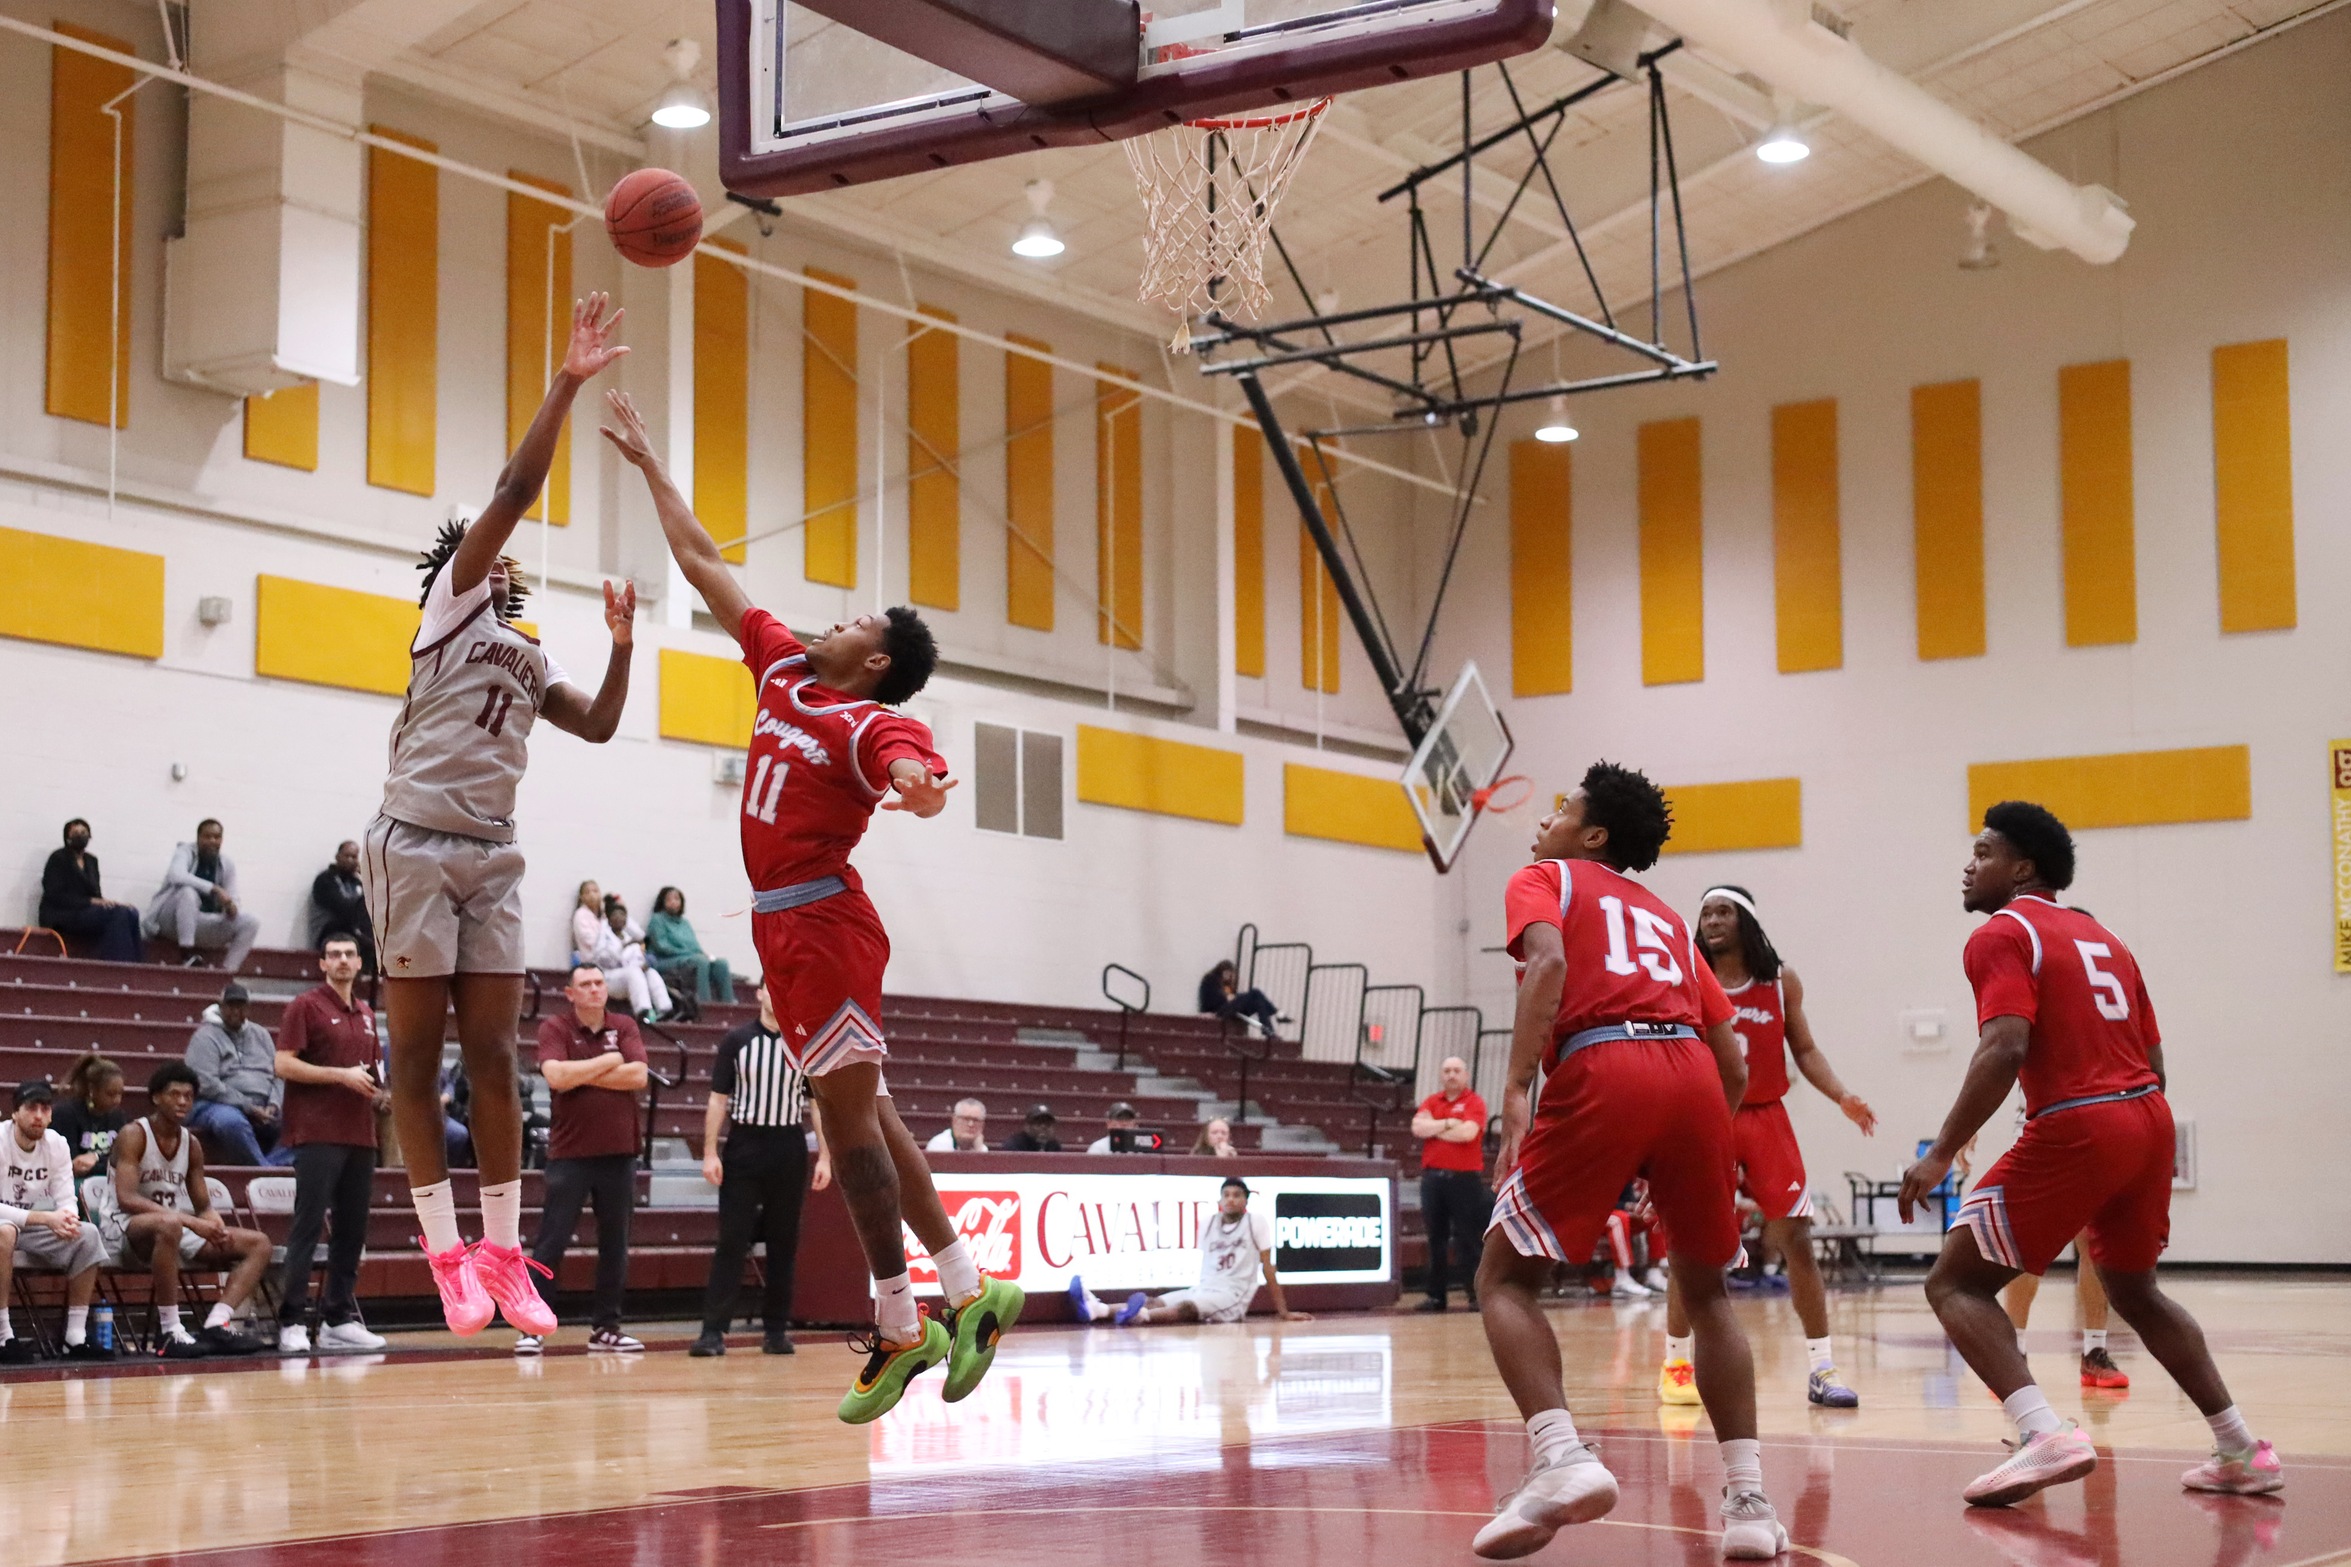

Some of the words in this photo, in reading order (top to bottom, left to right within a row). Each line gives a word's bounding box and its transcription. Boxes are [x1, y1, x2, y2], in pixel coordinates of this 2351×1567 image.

[475, 684, 514, 738] 11
[753, 707, 832, 767] Cougars
[745, 753, 791, 826] 11
[1598, 894, 1684, 988] 15
[2072, 937, 2131, 1021] 5
[1276, 1216, 1382, 1249] POWERADE
